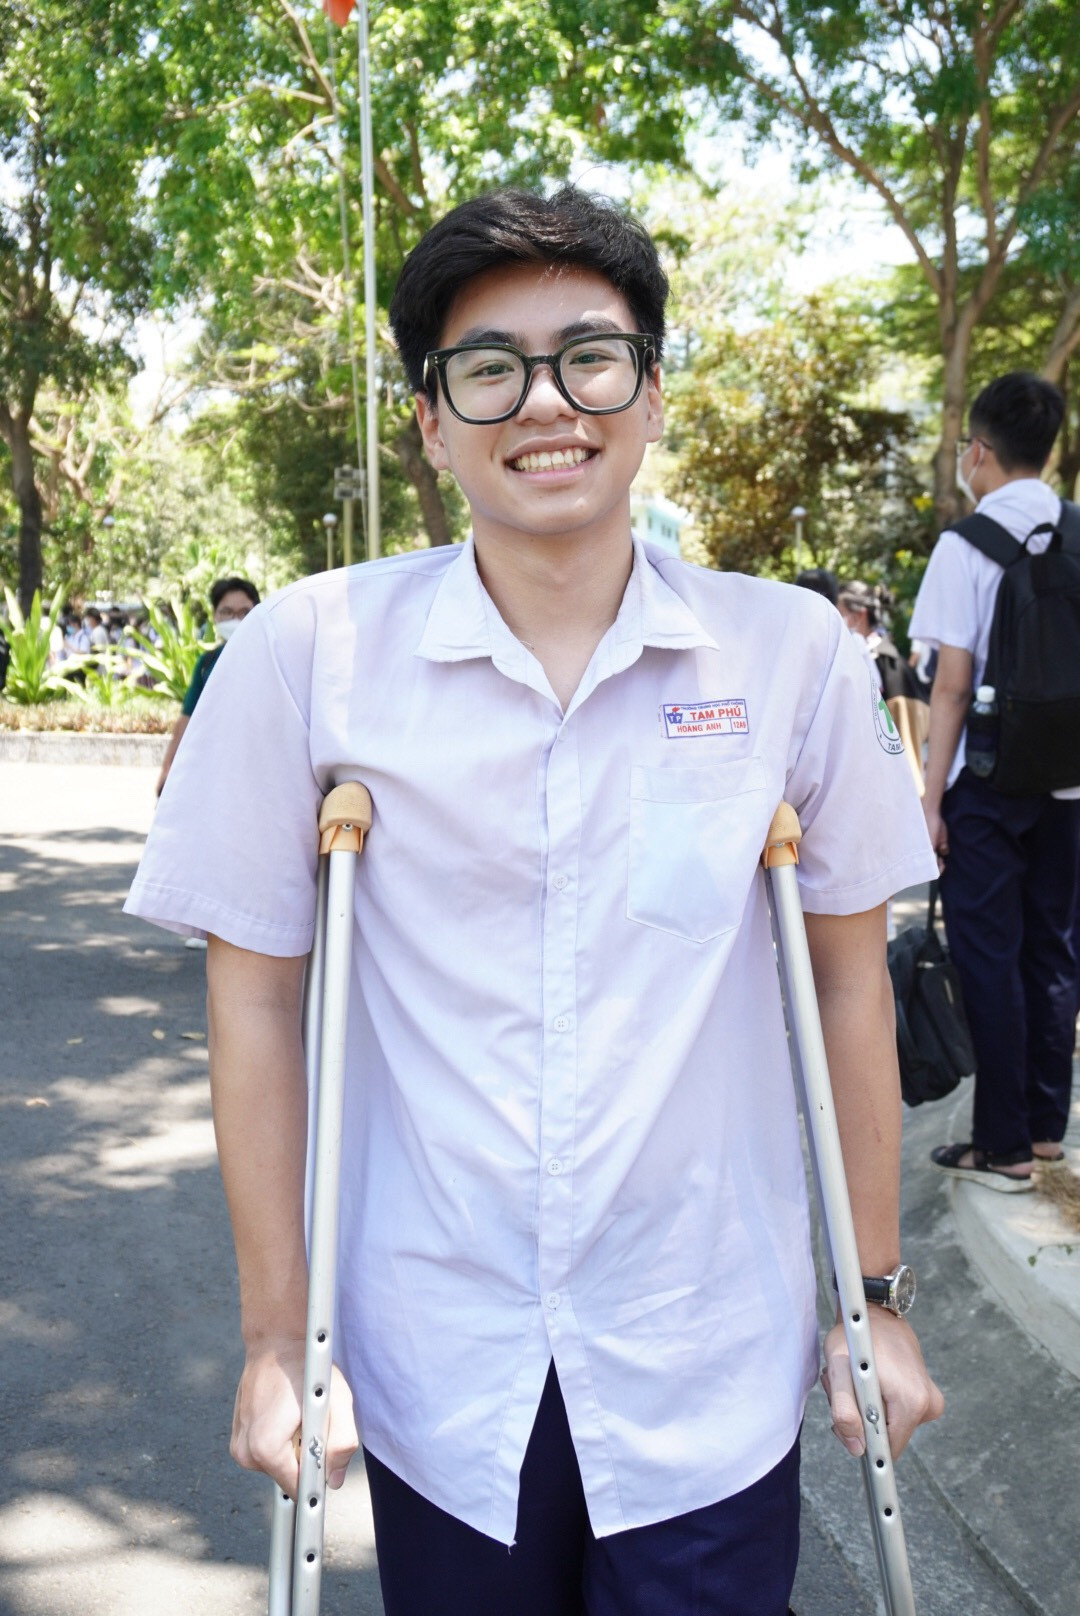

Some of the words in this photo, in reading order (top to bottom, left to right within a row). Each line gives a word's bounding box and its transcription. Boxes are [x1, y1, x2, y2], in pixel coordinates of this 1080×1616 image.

[690, 710, 714, 720] TAM
[718, 706, 741, 717] PHÚ
[677, 722, 703, 732] HOÀNG
[706, 722, 722, 730] ANH
